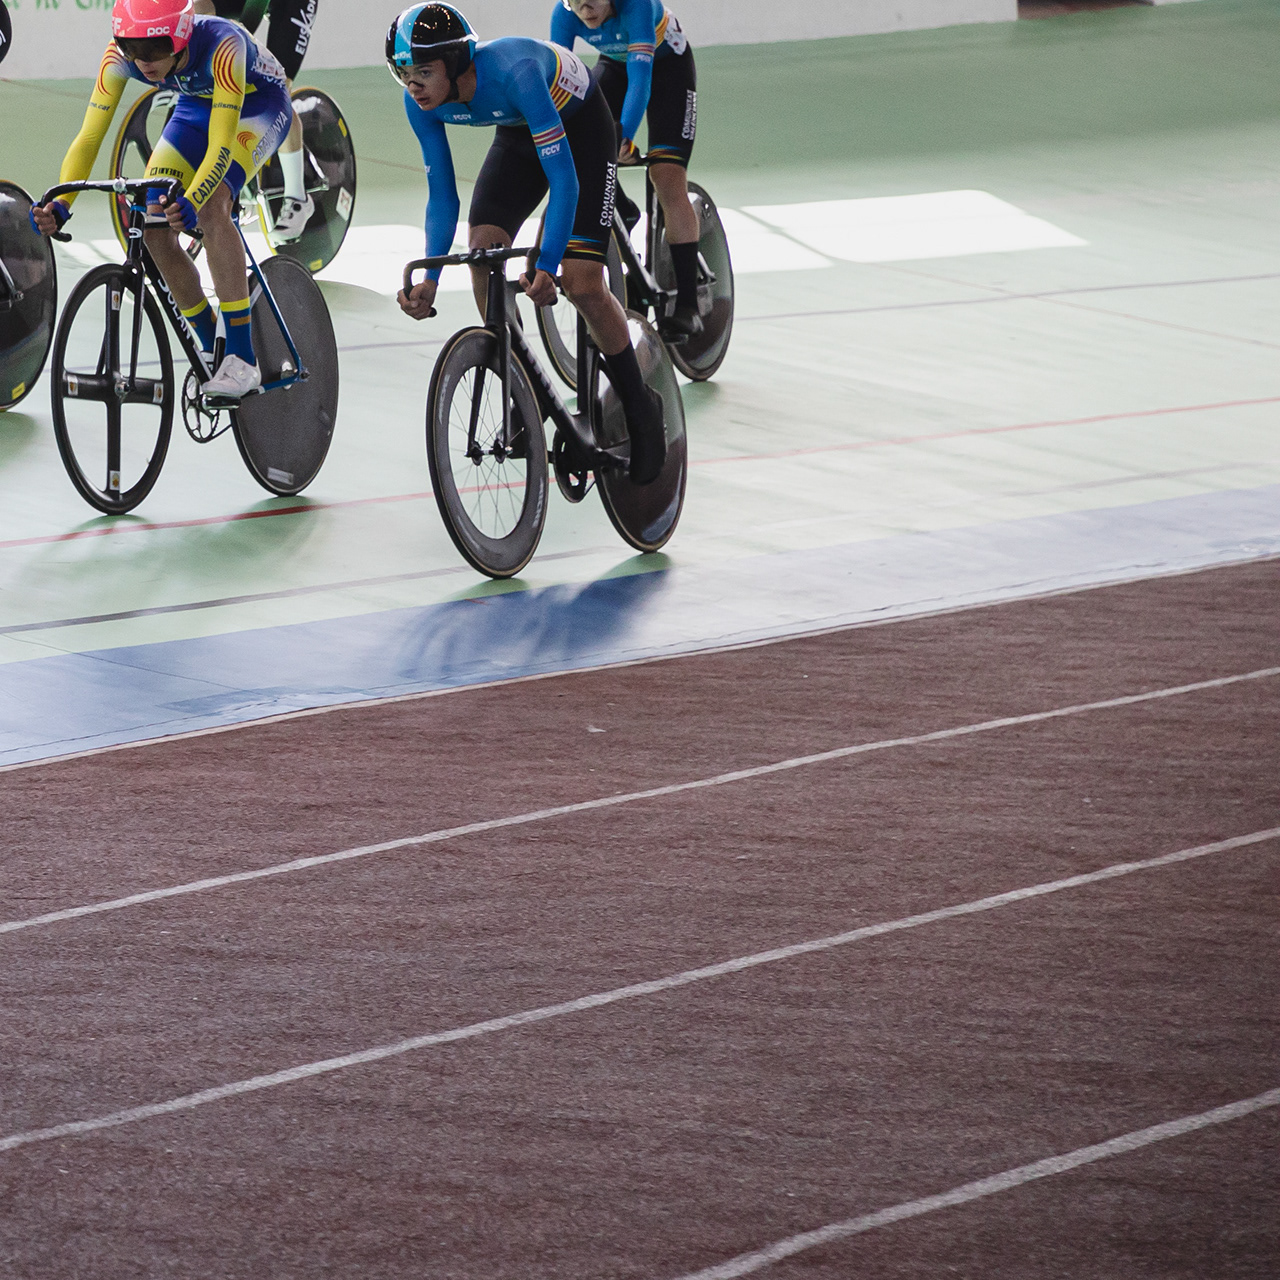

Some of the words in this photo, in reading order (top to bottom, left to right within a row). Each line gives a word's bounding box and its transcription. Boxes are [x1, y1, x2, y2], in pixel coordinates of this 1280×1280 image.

[251, 111, 288, 168] CATALUNYA
[541, 143, 561, 157] FCCV
[191, 146, 231, 206] CATALUNYA
[599, 161, 615, 227] COMUNITAT
